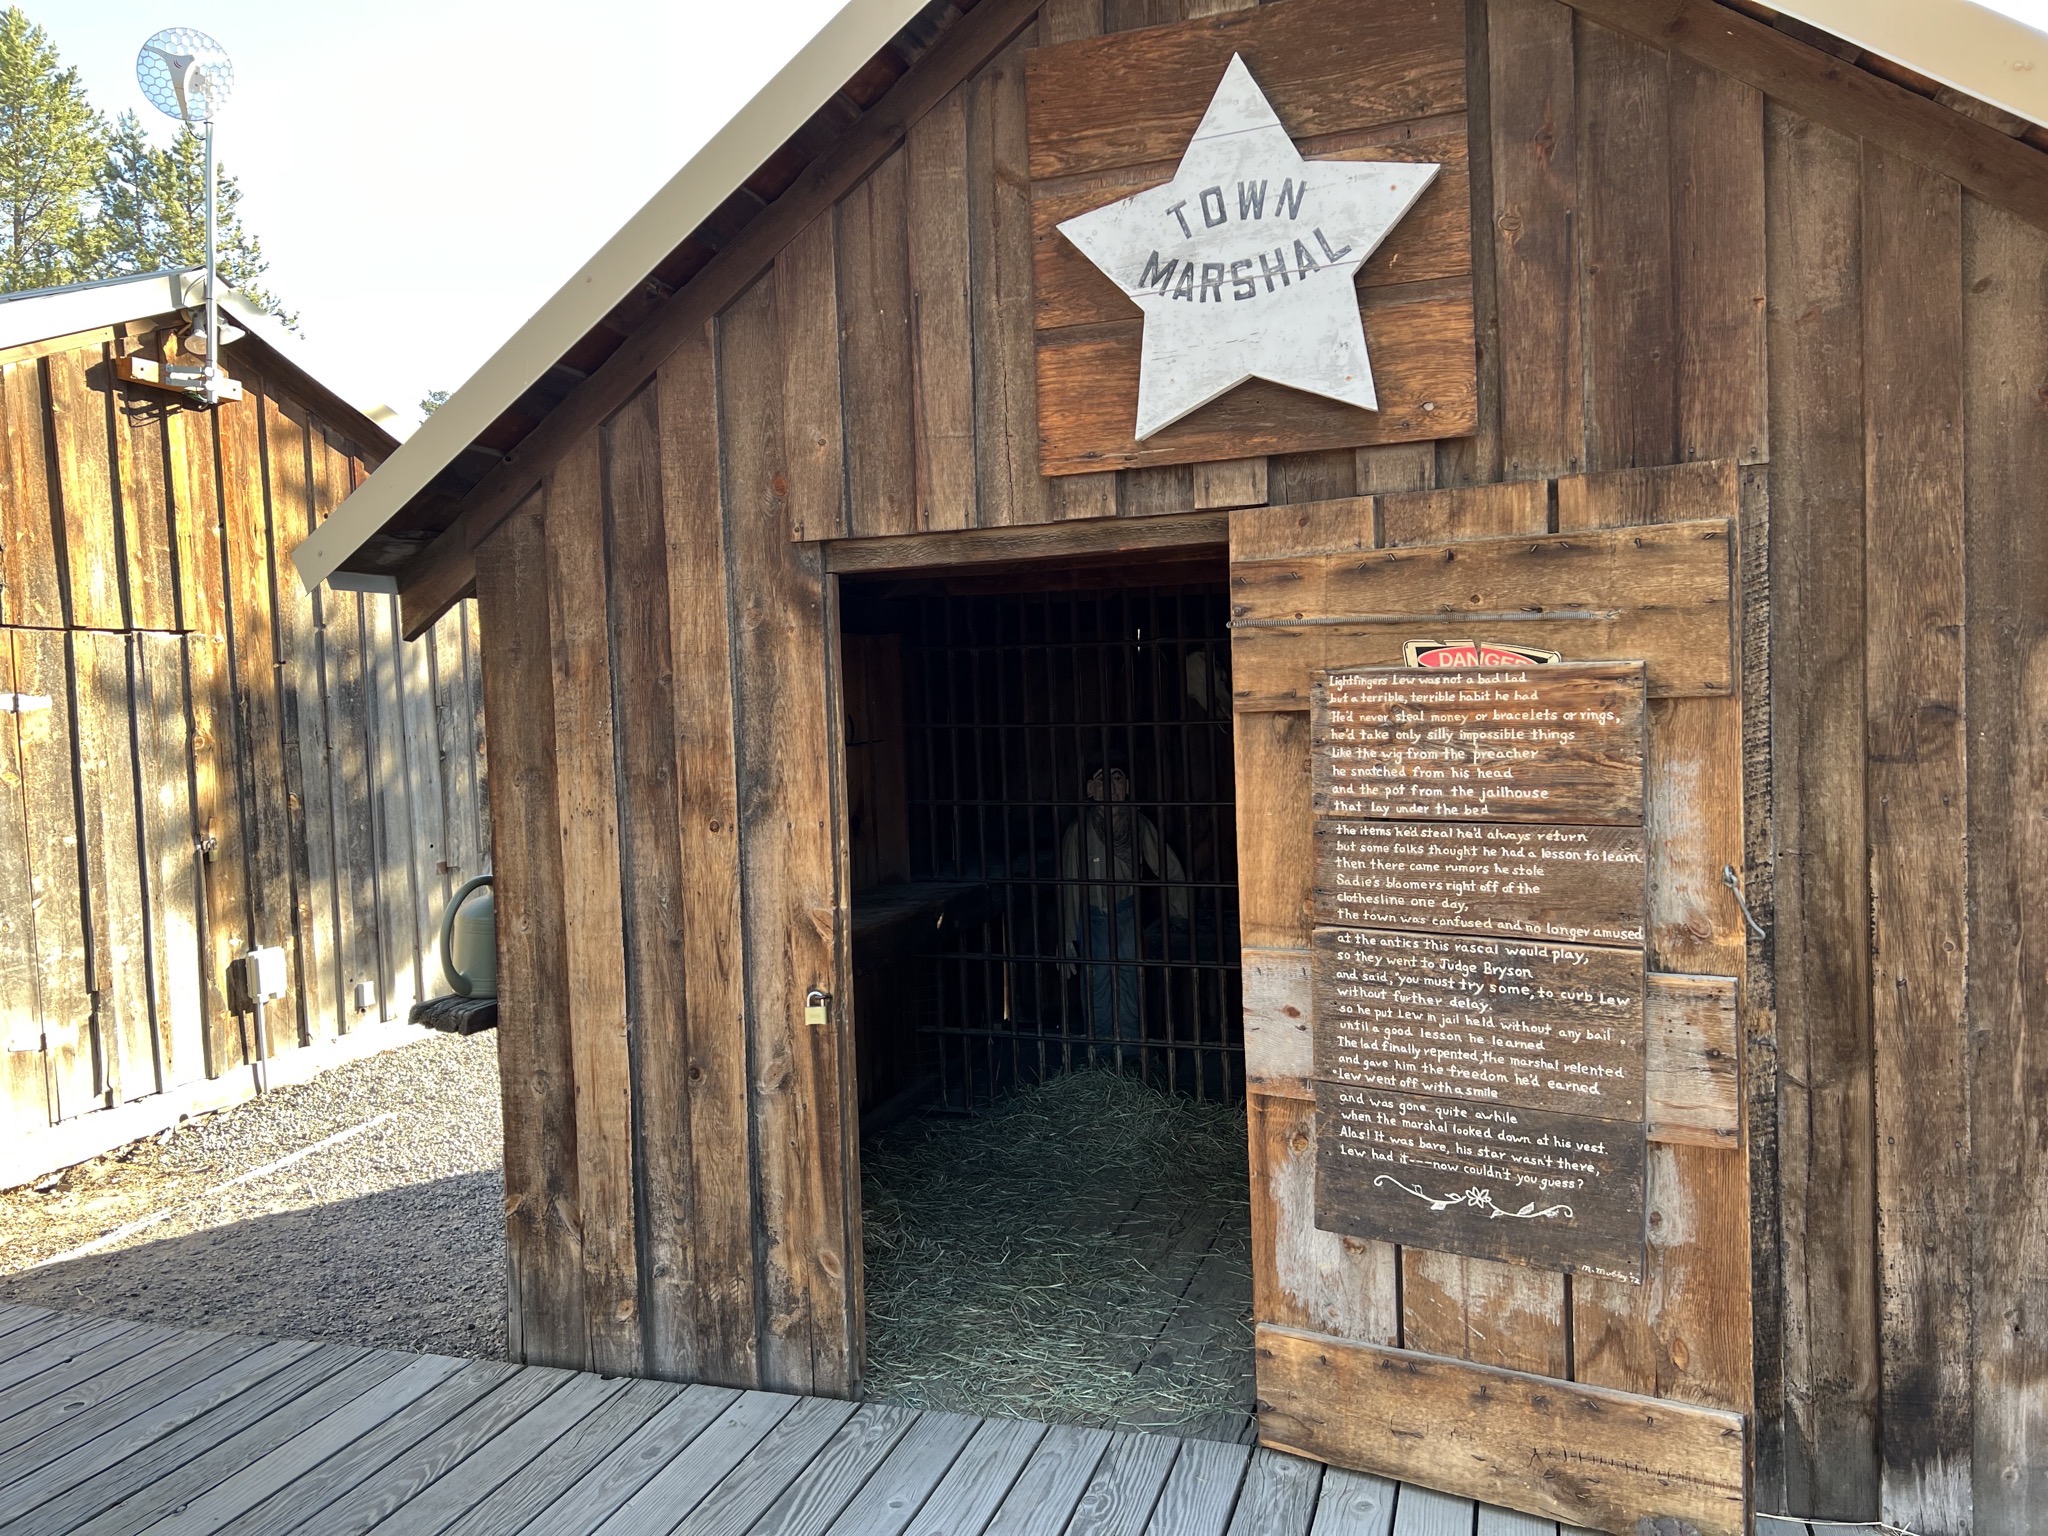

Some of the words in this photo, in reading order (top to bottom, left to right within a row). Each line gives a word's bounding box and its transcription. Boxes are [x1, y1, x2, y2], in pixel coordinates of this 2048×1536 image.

[1166, 178, 1307, 240] TOWN
[1137, 227, 1352, 303] MARSHAL
[1329, 675, 1388, 691] Lightfingers
[1443, 674, 1462, 684] not
[1478, 673, 1500, 684] bad
[1331, 711, 1353, 722] He'd
[1395, 711, 1424, 721] steal
[1431, 714, 1468, 725] money
[1493, 709, 1557, 720] bracelets
[1563, 712, 1577, 720] or
[1580, 708, 1620, 725] rings,
[1331, 729, 1355, 740] he'd
[1360, 729, 1389, 740] take
[1396, 729, 1421, 744] only
[1427, 728, 1453, 743] silly
[1460, 728, 1524, 745] impossible
[1530, 729, 1575, 745] things
[1356, 748, 1376, 758] the
[1381, 748, 1402, 764] wig
[1406, 748, 1437, 759] from
[1444, 747, 1465, 759] the
[1473, 748, 1538, 764] preacher
[1332, 765, 1346, 776] he
[1351, 766, 1406, 777] snatched
[1412, 767, 1444, 778] from
[1451, 767, 1469, 778] his
[1477, 768, 1513, 778] head
[1331, 784, 1354, 794] and
[1359, 784, 1378, 795] the
[1385, 784, 1405, 799] pot
[1411, 785, 1442, 796] from
[1451, 786, 1474, 797] the
[1479, 786, 1548, 802] jailhouse
[1334, 800, 1362, 812] that
[1371, 802, 1389, 816] lay
[1396, 804, 1430, 813] under
[1435, 803, 1458, 815] the
[1464, 805, 1489, 815] bed
[1336, 824, 1356, 835] the
[1360, 826, 1391, 836] items
[1395, 827, 1417, 837] he'd
[1421, 827, 1452, 838] steal
[1456, 827, 1482, 839] he'd
[1487, 828, 1531, 844] always
[1537, 830, 1588, 842] return
[1335, 857, 1365, 869] then
[1370, 859, 1405, 870] there
[1410, 862, 1440, 872] came
[1445, 865, 1489, 874] rumors
[1494, 863, 1509, 874] he
[1512, 865, 1544, 876] stole
[1336, 873, 1380, 887] Sadie's
[1386, 877, 1442, 890] bloomers
[1446, 880, 1477, 896] right
[1480, 881, 1499, 897] off
[1502, 882, 1516, 893] of
[1517, 883, 1540, 893] the
[1337, 892, 1405, 905] clothesline
[1411, 898, 1435, 907] one
[1441, 897, 1469, 913] day,
[1337, 908, 1359, 920] the
[1363, 910, 1396, 922] town
[1400, 915, 1426, 924] was
[1432, 916, 1493, 928] confused
[1497, 920, 1522, 931] and
[1525, 924, 1541, 933] no
[1547, 923, 1590, 941] longer
[1593, 926, 1643, 940] amused
[1337, 933, 1351, 943] at
[1355, 933, 1376, 945] the
[1380, 937, 1418, 948] antics
[1423, 939, 1449, 951] this
[1455, 944, 1498, 955] rascal
[1505, 946, 1548, 957] would
[1552, 948, 1589, 965] play,
[1337, 952, 1350, 960] so
[1354, 951, 1382, 966] they
[1386, 956, 1417, 966] went
[1420, 958, 1434, 969] to
[1440, 958, 1477, 976] Judge
[1484, 962, 1533, 980] Bryson
[1336, 969, 1358, 980] and
[1362, 972, 1393, 985] said,
[1424, 976, 1455, 989] must
[1459, 979, 1484, 995] try
[1489, 984, 1534, 1000] some,
[1537, 987, 1554, 998] to
[1561, 991, 1593, 1002] curb
[1337, 986, 1387, 1000] without
[1393, 991, 1442, 1005] further
[1449, 997, 1492, 1013] delay.
[1340, 1020, 1369, 1032] until
[1384, 1027, 1413, 1040] good
[1420, 1028, 1462, 1042] lesson
[1469, 1033, 1484, 1044] he
[1492, 1035, 1545, 1050] learned
[1339, 1054, 1360, 1064] and
[1363, 1058, 1388, 1070] gave
[1394, 1060, 1416, 1071] him
[1421, 1062, 1444, 1074] the
[1446, 1065, 1509, 1083] freedom
[1514, 1073, 1540, 1087] he'd
[1548, 1080, 1600, 1095] earned
[1365, 1074, 1397, 1086] went
[1400, 1078, 1418, 1088] off
[1422, 1081, 1452, 1093] with
[1454, 1087, 1463, 1095] a
[1466, 1087, 1498, 1098] smile
[1340, 1093, 1364, 1105] and
[1370, 1099, 1394, 1108] was
[1399, 1102, 1427, 1115] gone
[1435, 1106, 1468, 1119] quite
[1475, 1110, 1518, 1124] awhile
[1341, 1110, 1371, 1123] when
[1377, 1111, 1396, 1126] the
[1402, 1119, 1447, 1133] marshal
[1453, 1124, 1492, 1139] looked
[1498, 1129, 1531, 1144] down
[1537, 1133, 1549, 1146] at
[1554, 1136, 1572, 1148] his
[1576, 1142, 1609, 1154] vest.
[1339, 1125, 1370, 1140] Alas!
[1374, 1131, 1385, 1142] It
[1390, 1135, 1414, 1147] was
[1419, 1137, 1450, 1154] bare,
[1456, 1142, 1472, 1155] his
[1477, 1146, 1506, 1160] star
[1511, 1154, 1553, 1167] wasn't
[1557, 1157, 1600, 1176] there,
[1372, 1148, 1394, 1161] had
[1463, 1164, 1511, 1180] couldn't
[1516, 1173, 1538, 1186] you
[1539, 1178, 1584, 1190] guess?
